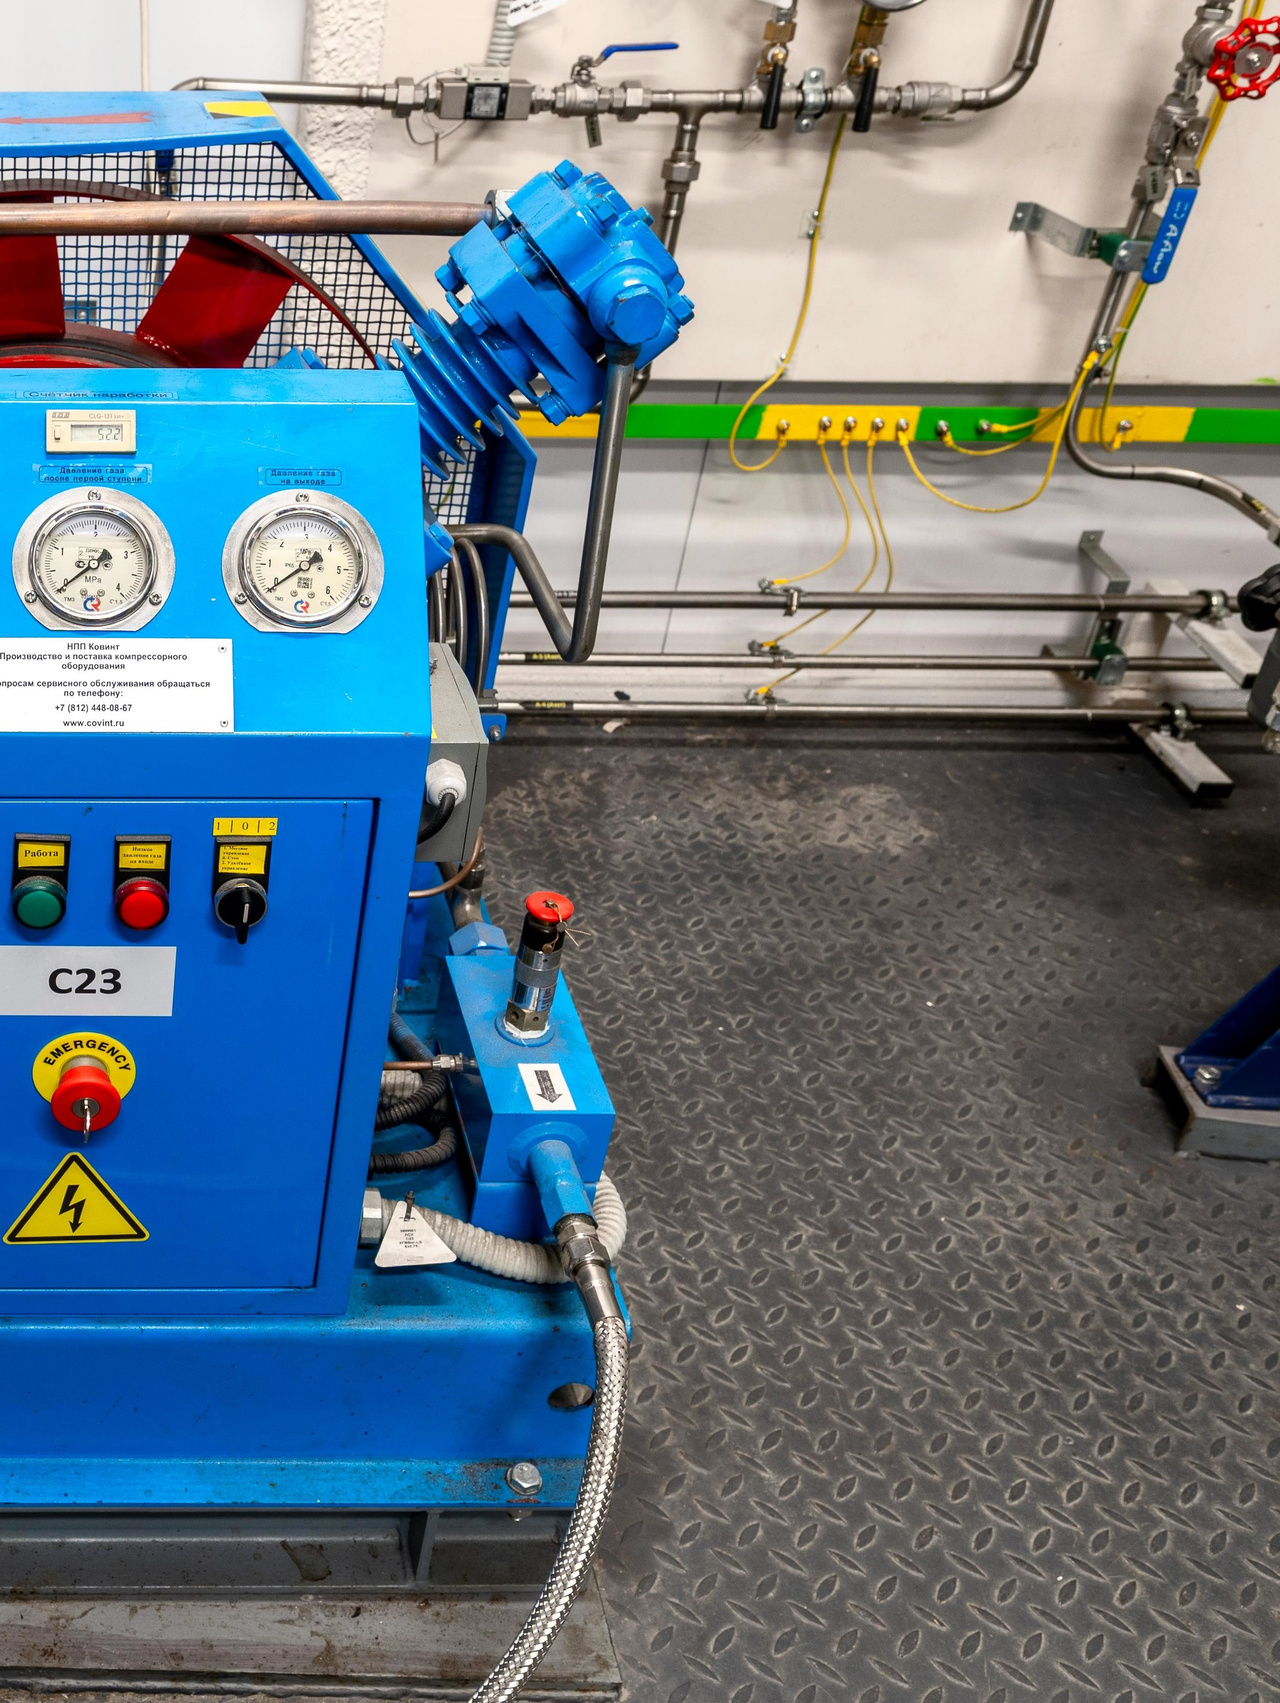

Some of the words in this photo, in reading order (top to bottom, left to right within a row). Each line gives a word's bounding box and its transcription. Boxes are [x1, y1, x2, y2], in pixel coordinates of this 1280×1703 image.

[28, 390, 89, 398] Счётчик
[93, 391, 167, 399] наработки
[270, 469, 313, 477] Давление
[73, 475, 104, 483] первой
[327, 543, 333, 552] 4
[123, 550, 129, 560] 3
[336, 565, 342, 575] 5
[84, 576, 102, 584] MPa
[115, 583, 121, 592] 4
[325, 586, 331, 595] 6
[0, 652, 63, 661] Производство
[115, 654, 188, 662] компрессорного
[61, 662, 125, 671] оборудования
[90, 679, 154, 689] обслуживания
[156, 679, 211, 689] обращаться
[77, 690, 124, 699] телефону:
[55, 704, 65, 712] +7
[67, 703, 89, 713] (812)
[91, 703, 132, 712] 448-08-67
[62, 719, 125, 727] www.covint.ru
[242, 821, 249, 831] 0
[269, 821, 276, 831] 2
[24, 849, 59, 857] Работа
[48, 967, 122, 994] C23
[43, 1039, 131, 1071] EMERGENCY
